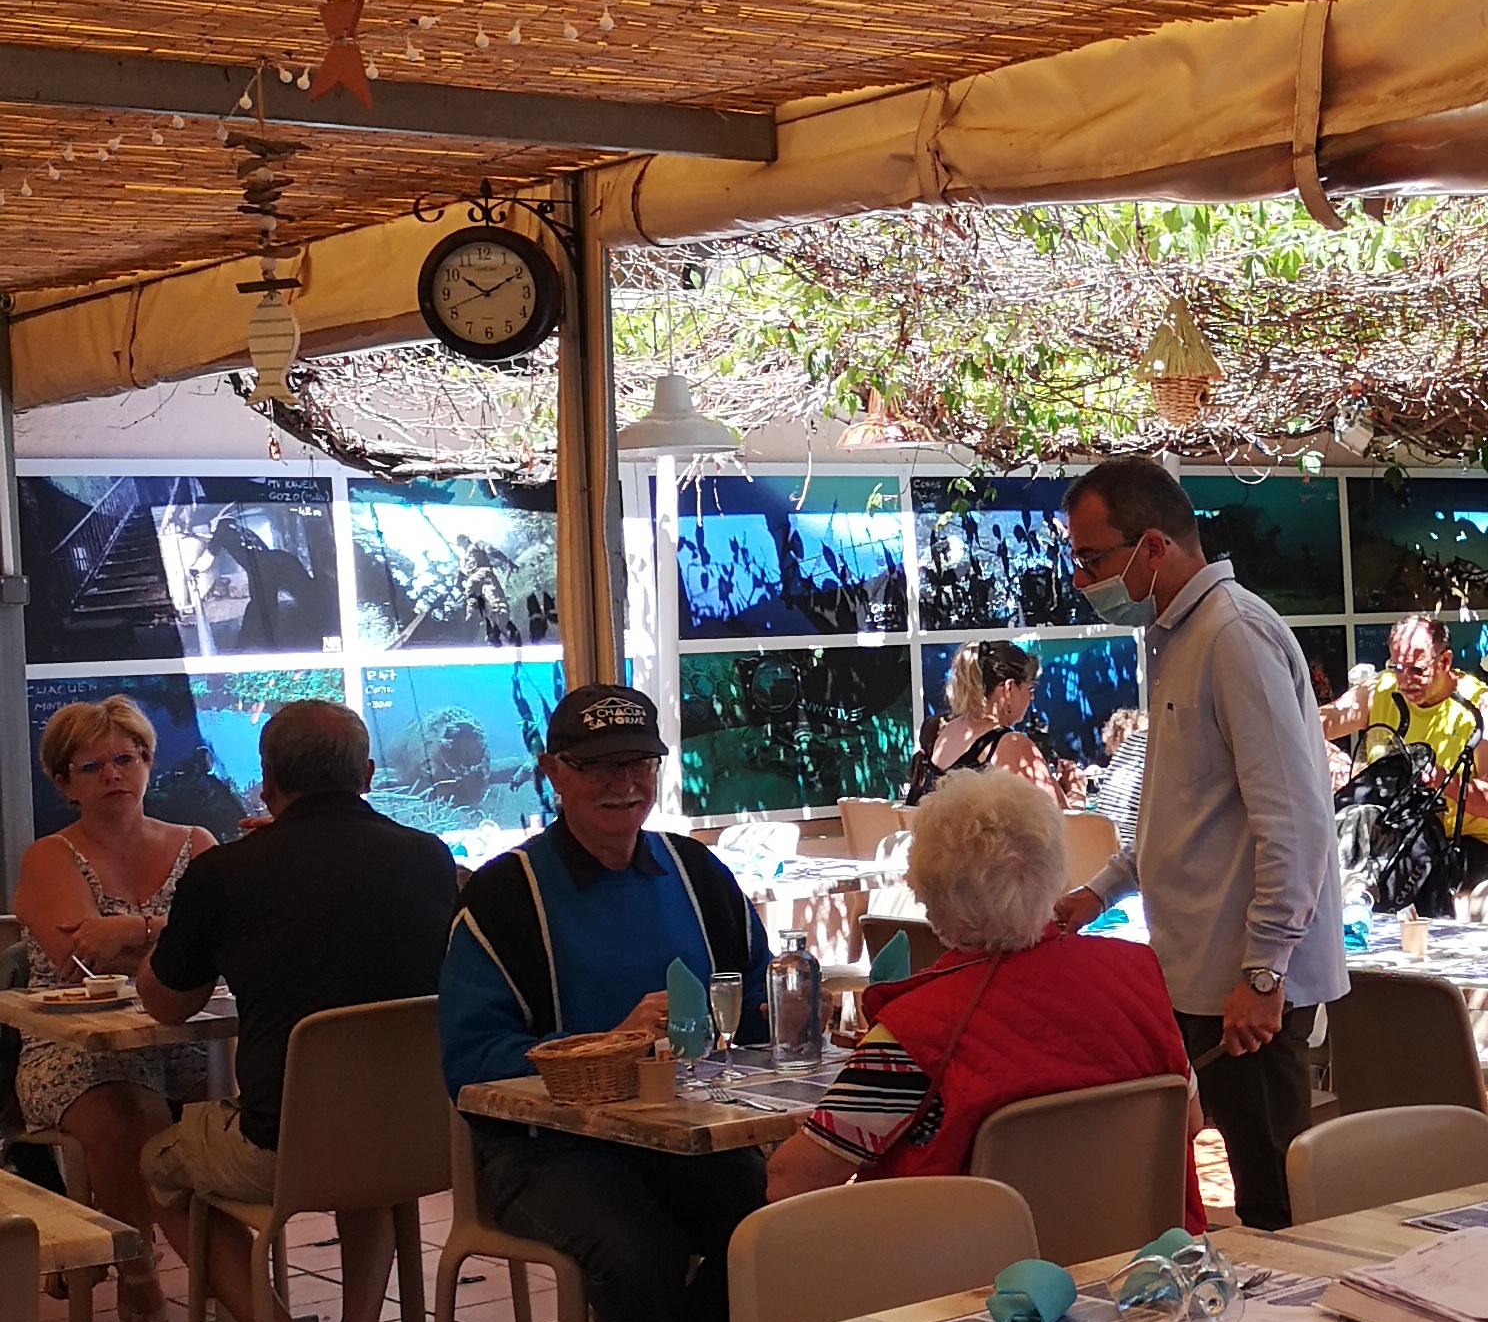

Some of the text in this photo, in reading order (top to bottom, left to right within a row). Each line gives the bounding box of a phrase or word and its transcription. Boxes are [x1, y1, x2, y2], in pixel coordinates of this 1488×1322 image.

[476, 247, 492, 261] 12
[459, 255, 474, 268] 11
[445, 268, 460, 283] 10
[515, 266, 523, 280] 2
[442, 287, 451, 302] 9
[522, 285, 531, 300] 3
[450, 306, 459, 320] 8
[519, 305, 527, 319] 4
[465, 321, 473, 335] 7
[485, 326, 494, 340] 6
[504, 320, 513, 334] 5
[596, 706, 647, 718] CHACUN
[588, 718, 607, 731] SA
[1395, 865, 1423, 905] CASTLE
